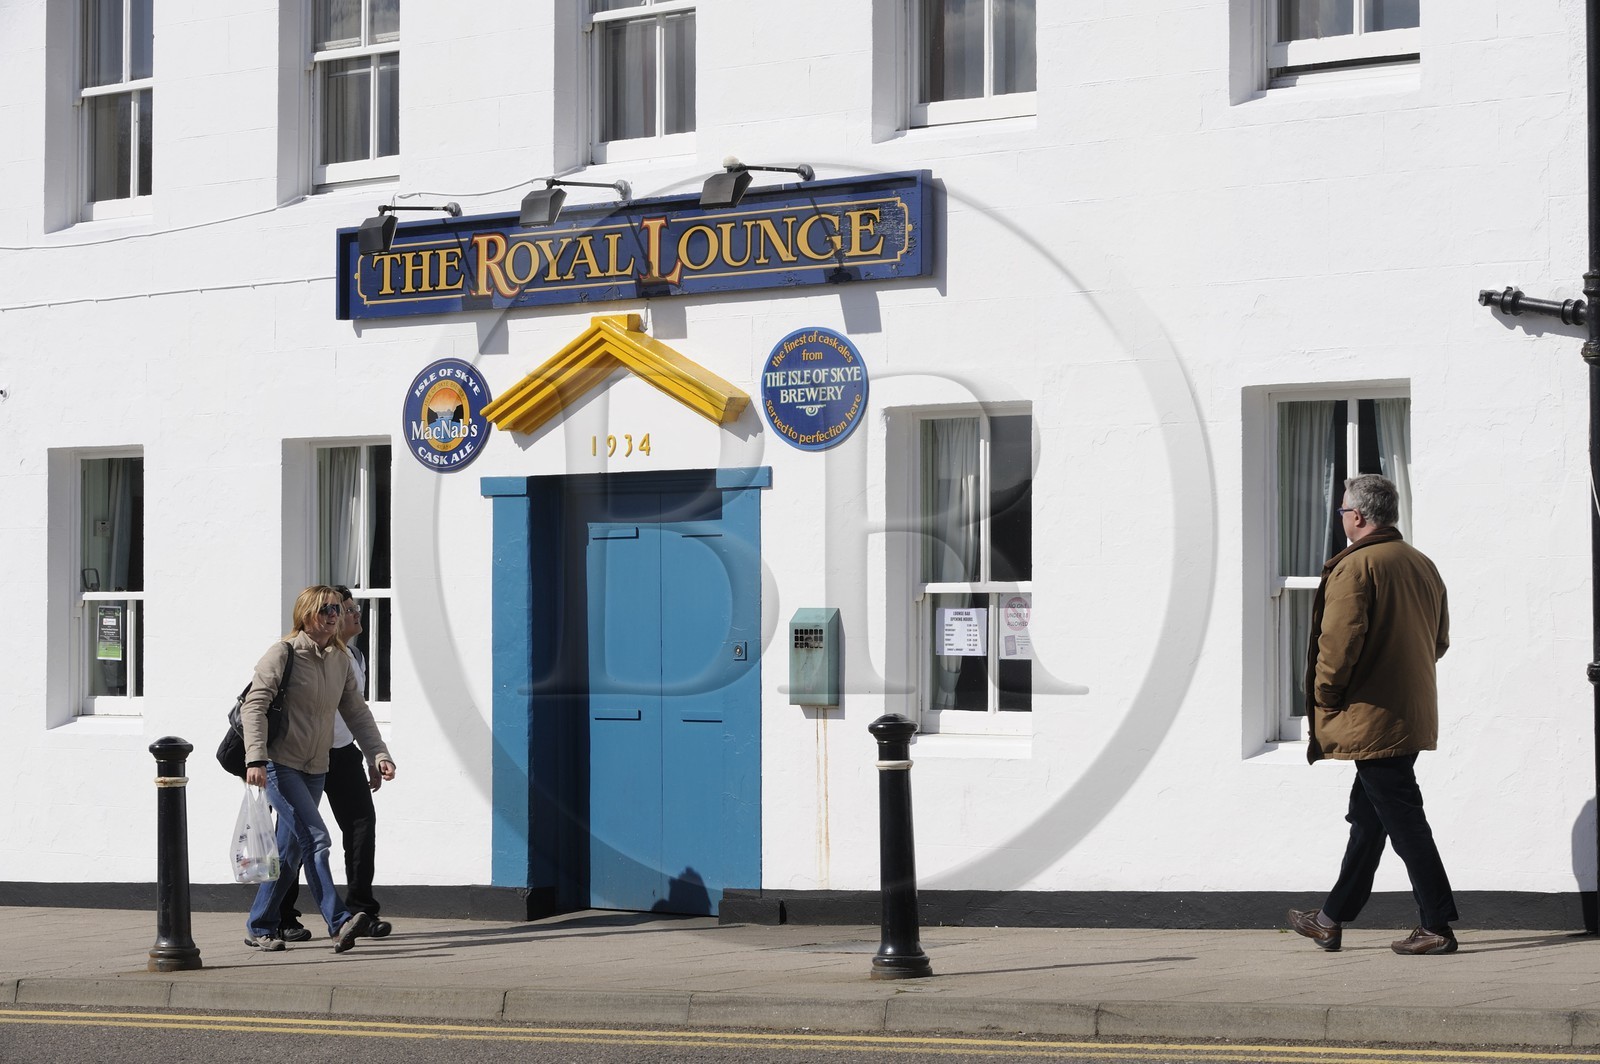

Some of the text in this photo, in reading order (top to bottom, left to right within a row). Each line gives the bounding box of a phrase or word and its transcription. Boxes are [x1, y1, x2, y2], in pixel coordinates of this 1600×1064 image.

[372, 206, 885, 299] THE ROYAL LOUNGE
[771, 330, 854, 367] the finest of cask ales
[801, 349, 823, 361] from
[414, 368, 481, 398] ISLE OF SKYE
[764, 366, 862, 388] THE ISLE OF SKYE
[780, 385, 846, 404] BREWERY
[411, 417, 478, 441] MacNab's
[765, 393, 862, 445] served to perfection here
[417, 441, 475, 465] CASK ALE
[591, 432, 651, 458] 1934
